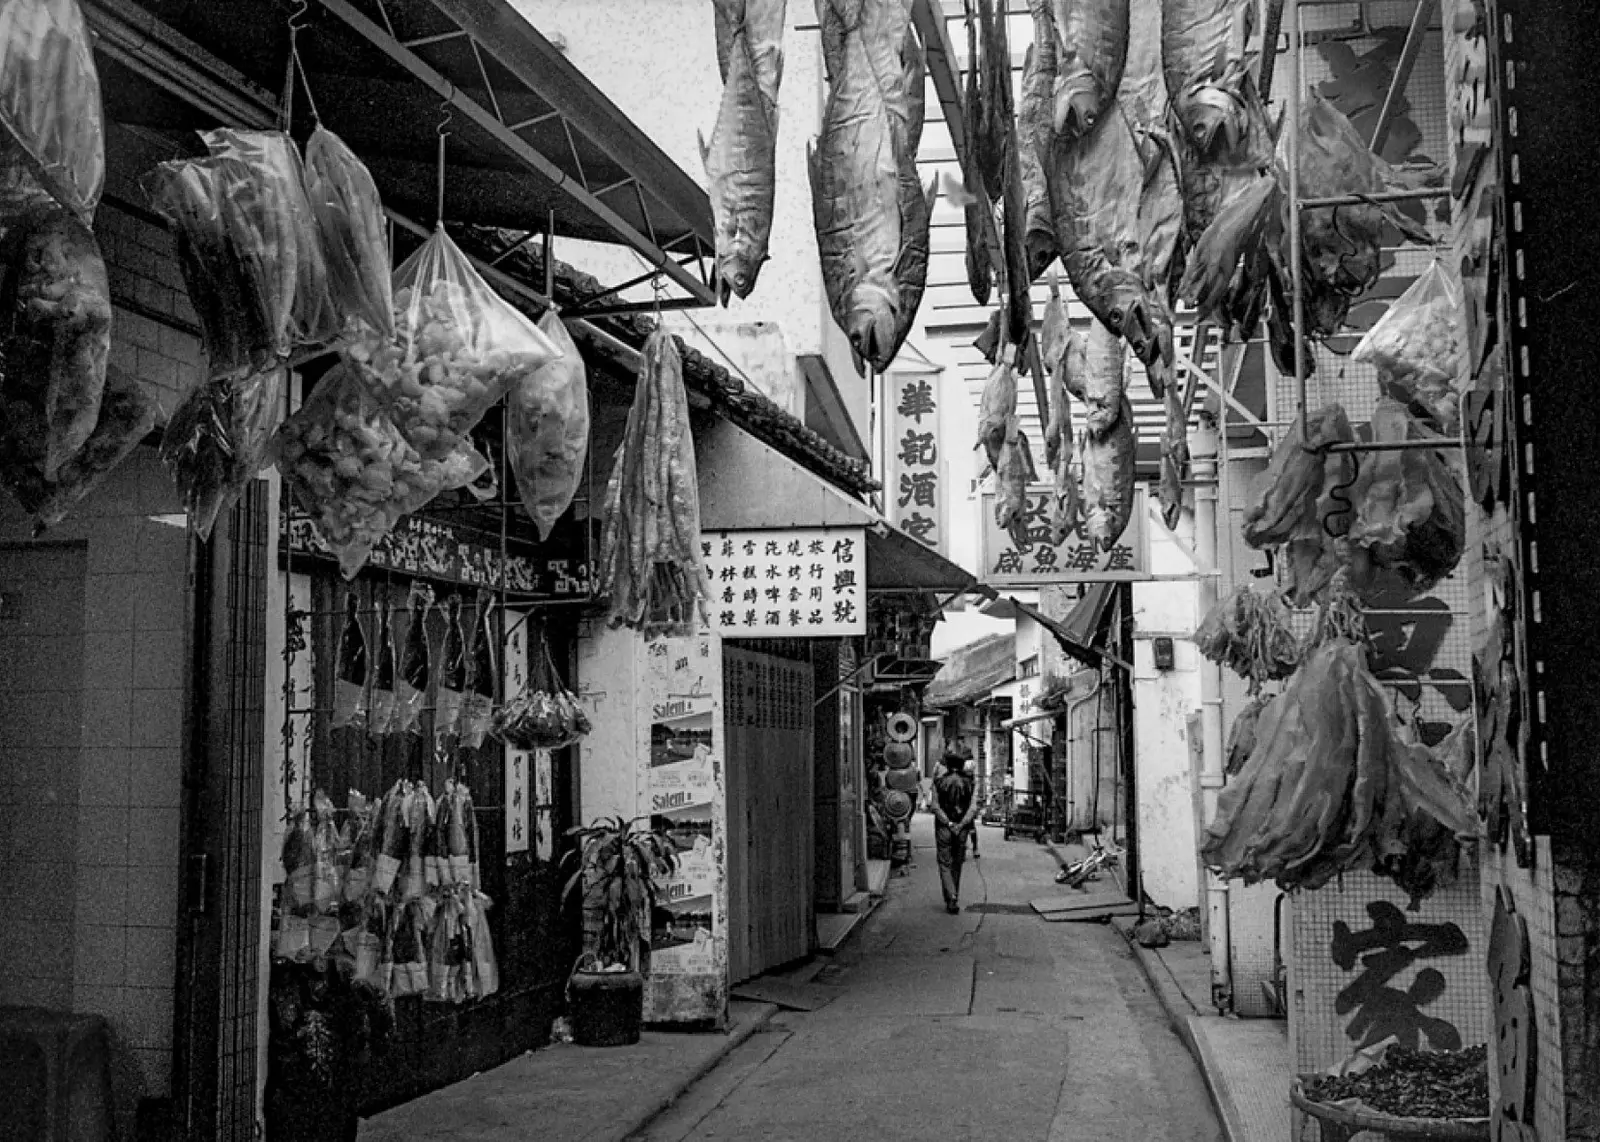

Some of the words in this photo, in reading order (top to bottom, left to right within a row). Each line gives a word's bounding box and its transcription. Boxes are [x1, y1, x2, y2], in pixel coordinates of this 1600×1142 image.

[807, 539, 825, 625] 旅行用品
[831, 538, 857, 624] 信興號
[652, 701, 685, 720] Salem
[652, 791, 685, 812] Salem
